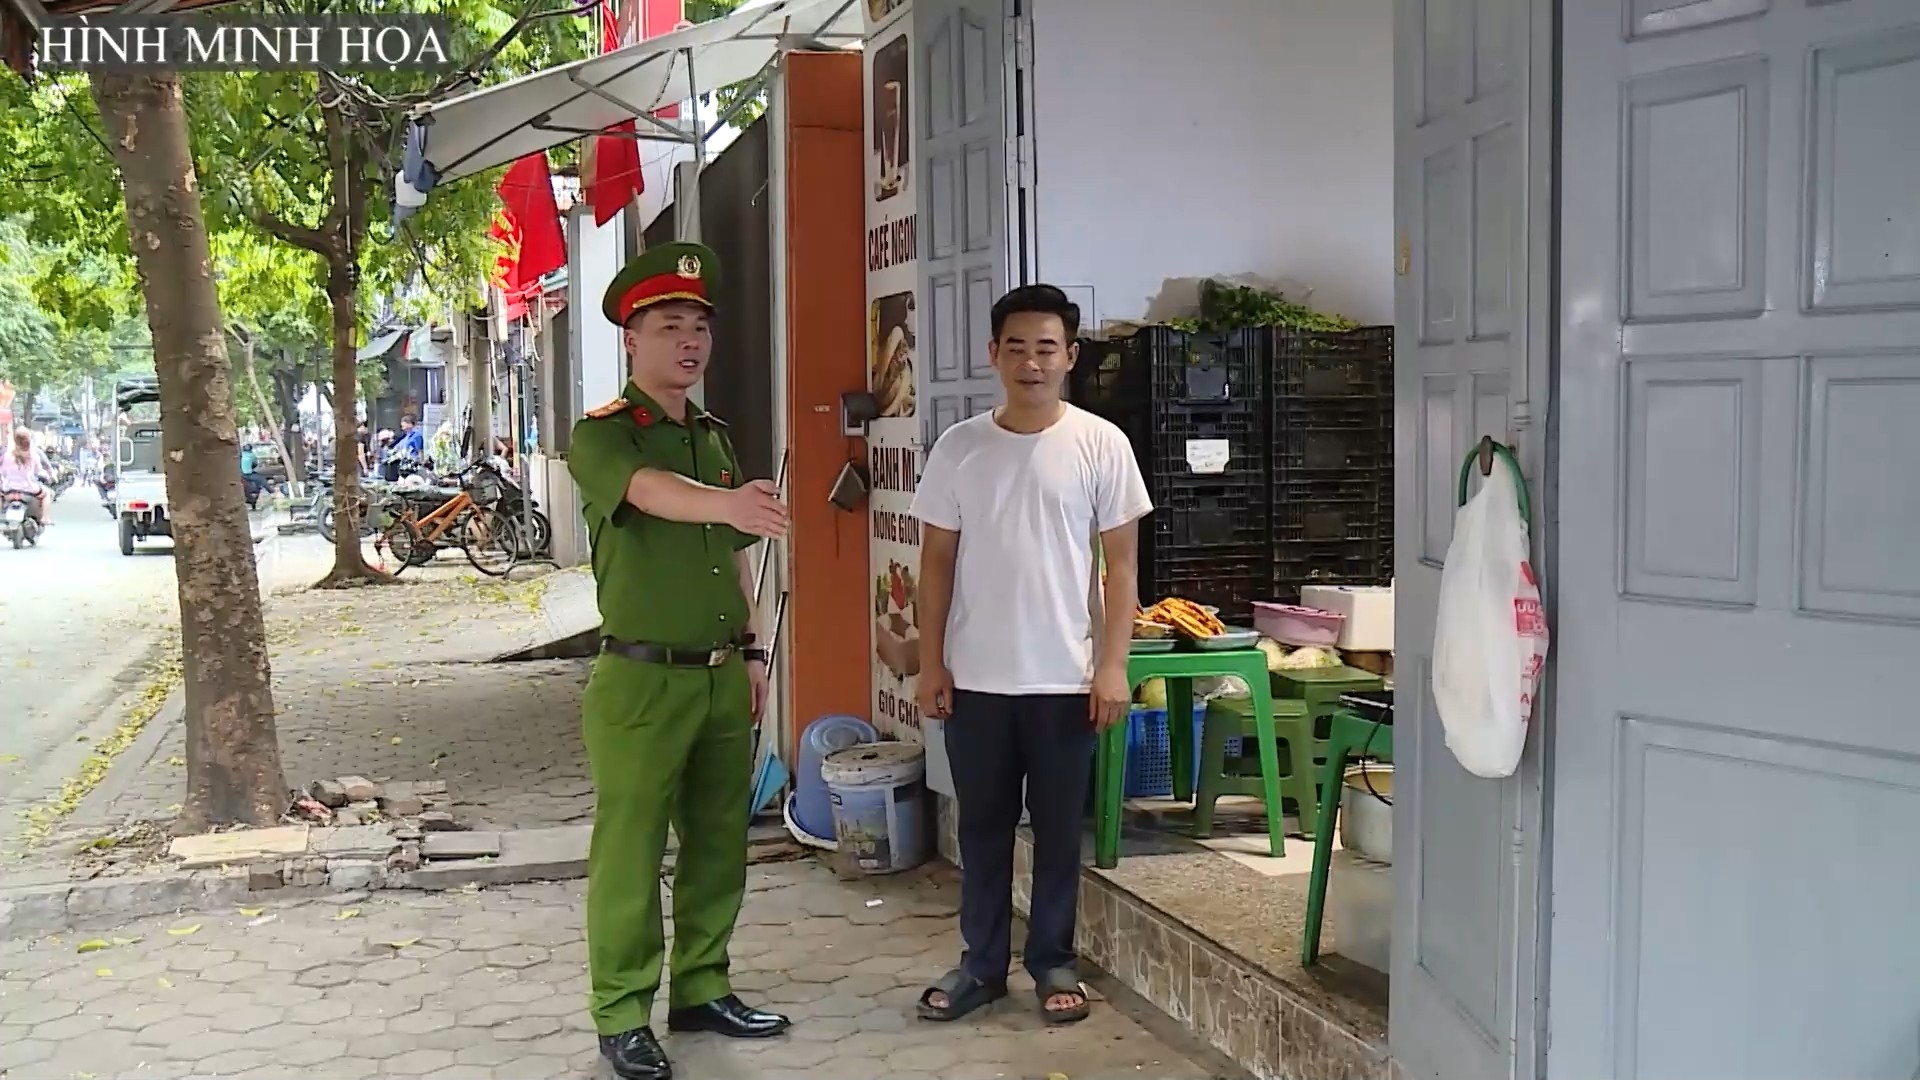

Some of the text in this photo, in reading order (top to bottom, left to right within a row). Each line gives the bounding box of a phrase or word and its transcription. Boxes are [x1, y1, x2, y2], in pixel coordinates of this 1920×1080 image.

[868, 214, 917, 272] CAFÉ NGON
[872, 437, 899, 491] BÁNH
[873, 504, 897, 542] NÓNG
